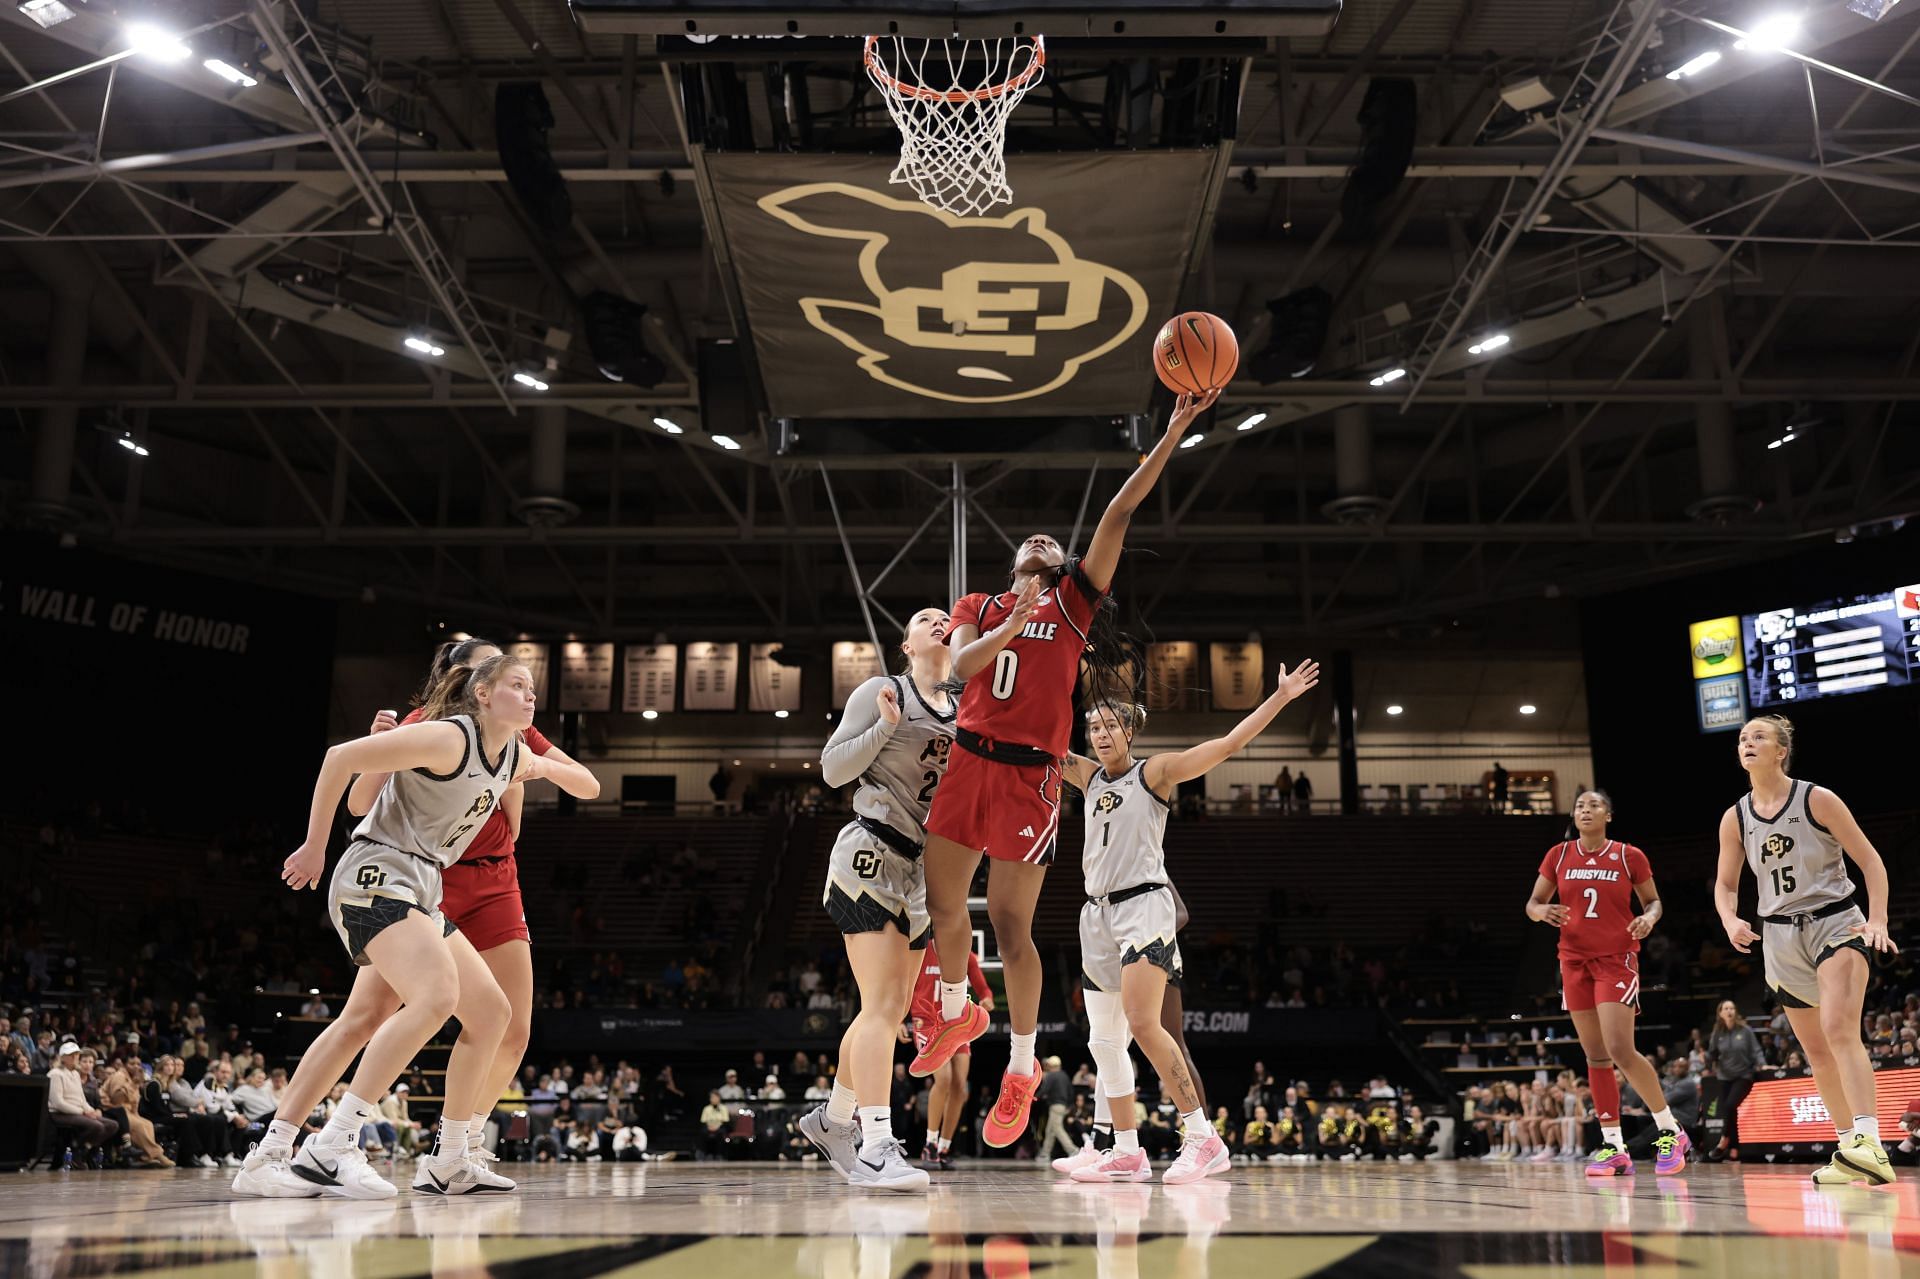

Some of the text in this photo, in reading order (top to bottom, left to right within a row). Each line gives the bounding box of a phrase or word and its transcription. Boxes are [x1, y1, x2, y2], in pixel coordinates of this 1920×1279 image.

[19, 584, 251, 655] WALL OF HONOR
[991, 649, 1019, 700] 0
[1703, 683, 1739, 700] BUILT
[1779, 686, 1796, 699] 13
[1705, 709, 1741, 724] TOUGH
[1103, 822, 1110, 847] 1
[852, 849, 882, 879] CU
[1565, 868, 1620, 882] LOUISVILLE
[1771, 866, 1796, 896] 15
[1583, 887, 1598, 918] 2
